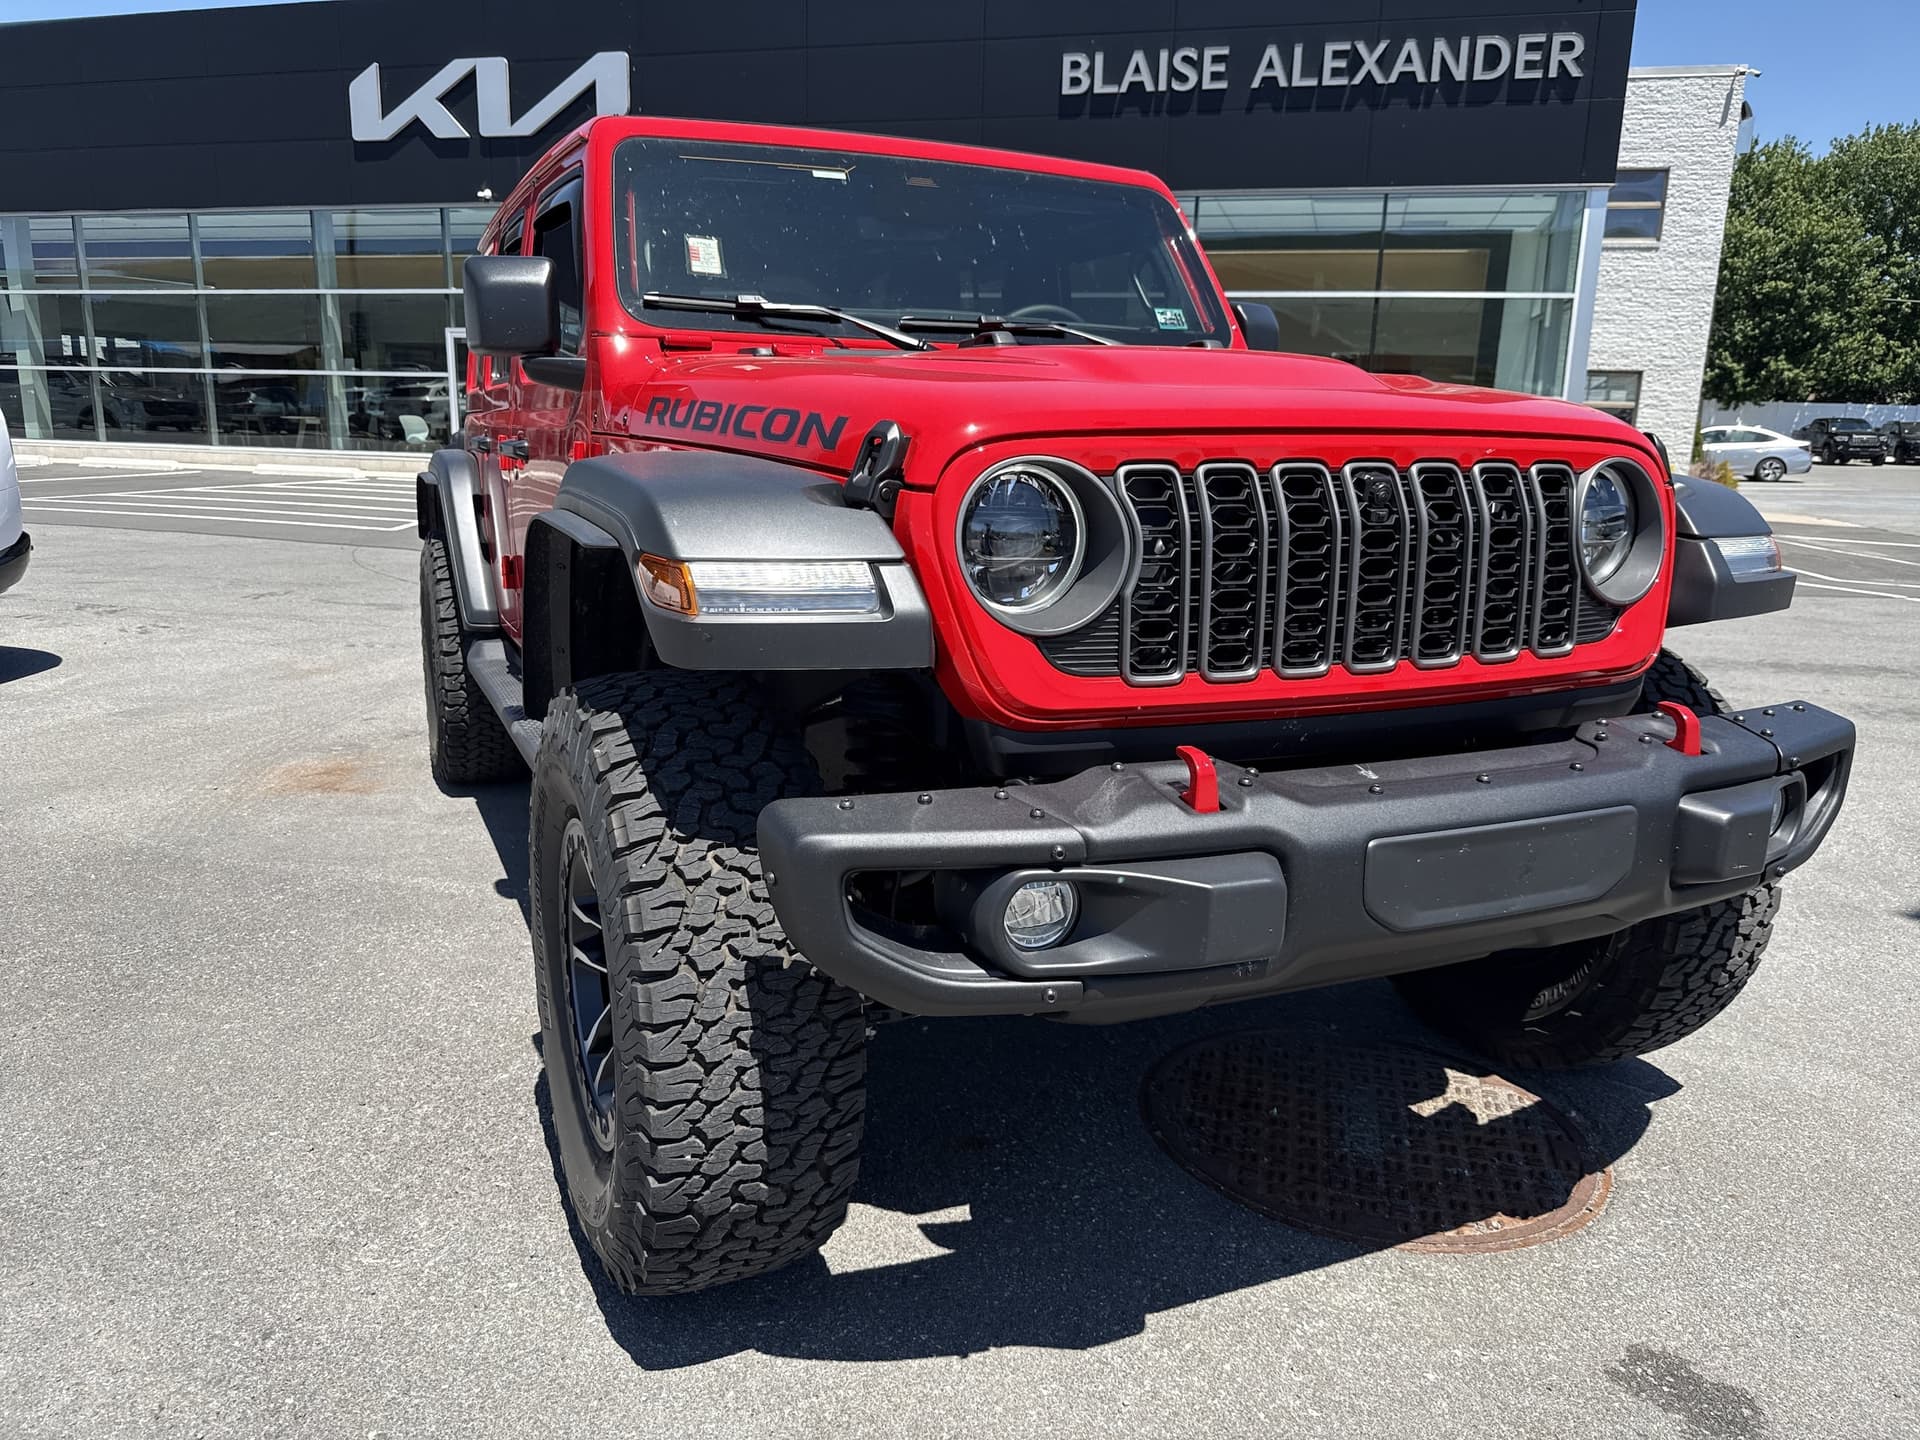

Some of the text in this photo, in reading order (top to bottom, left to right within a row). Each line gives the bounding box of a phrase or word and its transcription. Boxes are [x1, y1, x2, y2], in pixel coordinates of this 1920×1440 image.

[349, 51, 630, 141] KIA
[1061, 31, 1586, 96] BLAISE ALEXANDER
[645, 397, 848, 450] RUBICON
